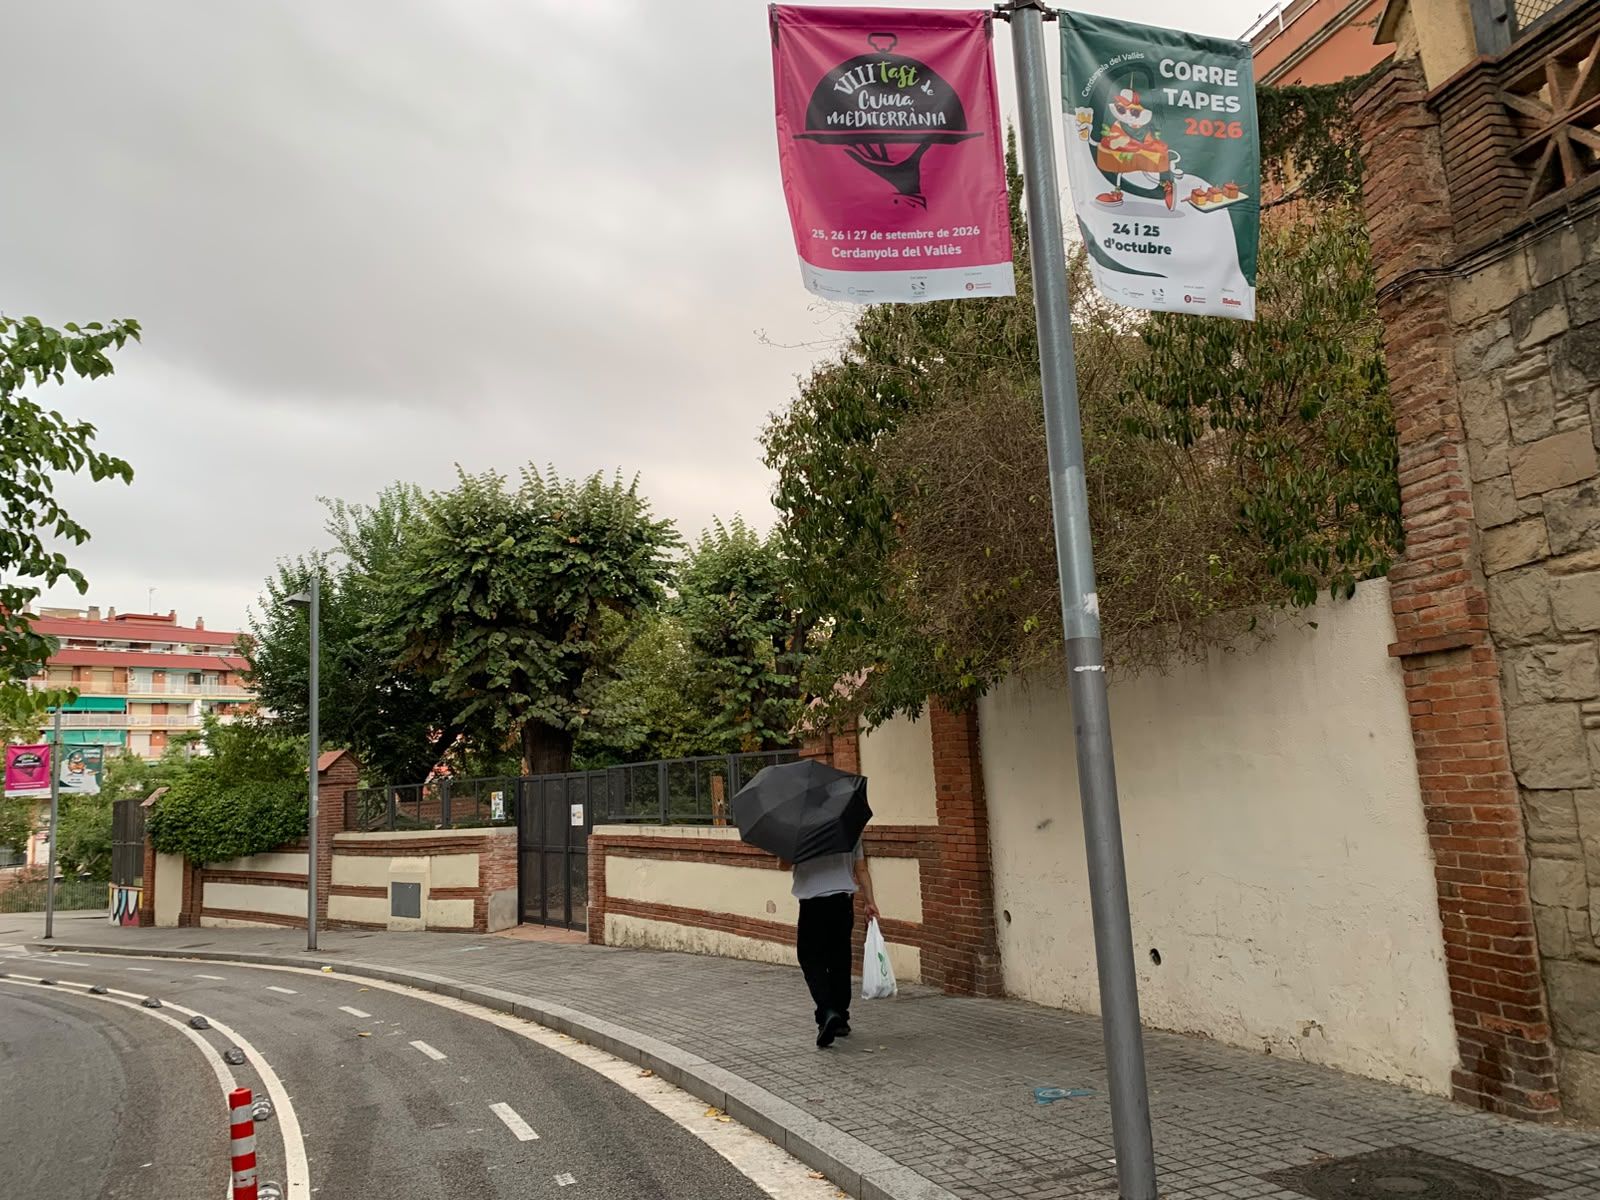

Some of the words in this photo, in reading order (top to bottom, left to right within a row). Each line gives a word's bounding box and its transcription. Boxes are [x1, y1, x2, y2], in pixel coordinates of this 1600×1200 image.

[1109, 55, 1122, 66] del
[1121, 51, 1145, 61] Vallès
[834, 63, 877, 95] VIII
[877, 60, 919, 88] Tast
[920, 80, 935, 96] de
[1159, 58, 1239, 87] CORRE
[858, 90, 914, 110] Cuina
[1162, 87, 1241, 113] TAPES
[827, 107, 947, 128] MEDITERRÀNIA
[1184, 117, 1243, 139] 2026
[811, 228, 828, 241] 25,
[831, 230, 844, 240] 26
[854, 230, 867, 240] 27
[870, 230, 882, 240] de
[885, 228, 934, 240] setembre
[936, 228, 949, 238] de
[952, 226, 980, 237] 2026
[1112, 222, 1131, 235] 24
[1134, 222, 1139, 236] i
[1143, 224, 1160, 237] 25
[831, 247, 899, 260] Cerdanyola
[902, 246, 921, 257] del
[924, 244, 962, 256] Vallès
[1103, 237, 1172, 255] d'octubre
